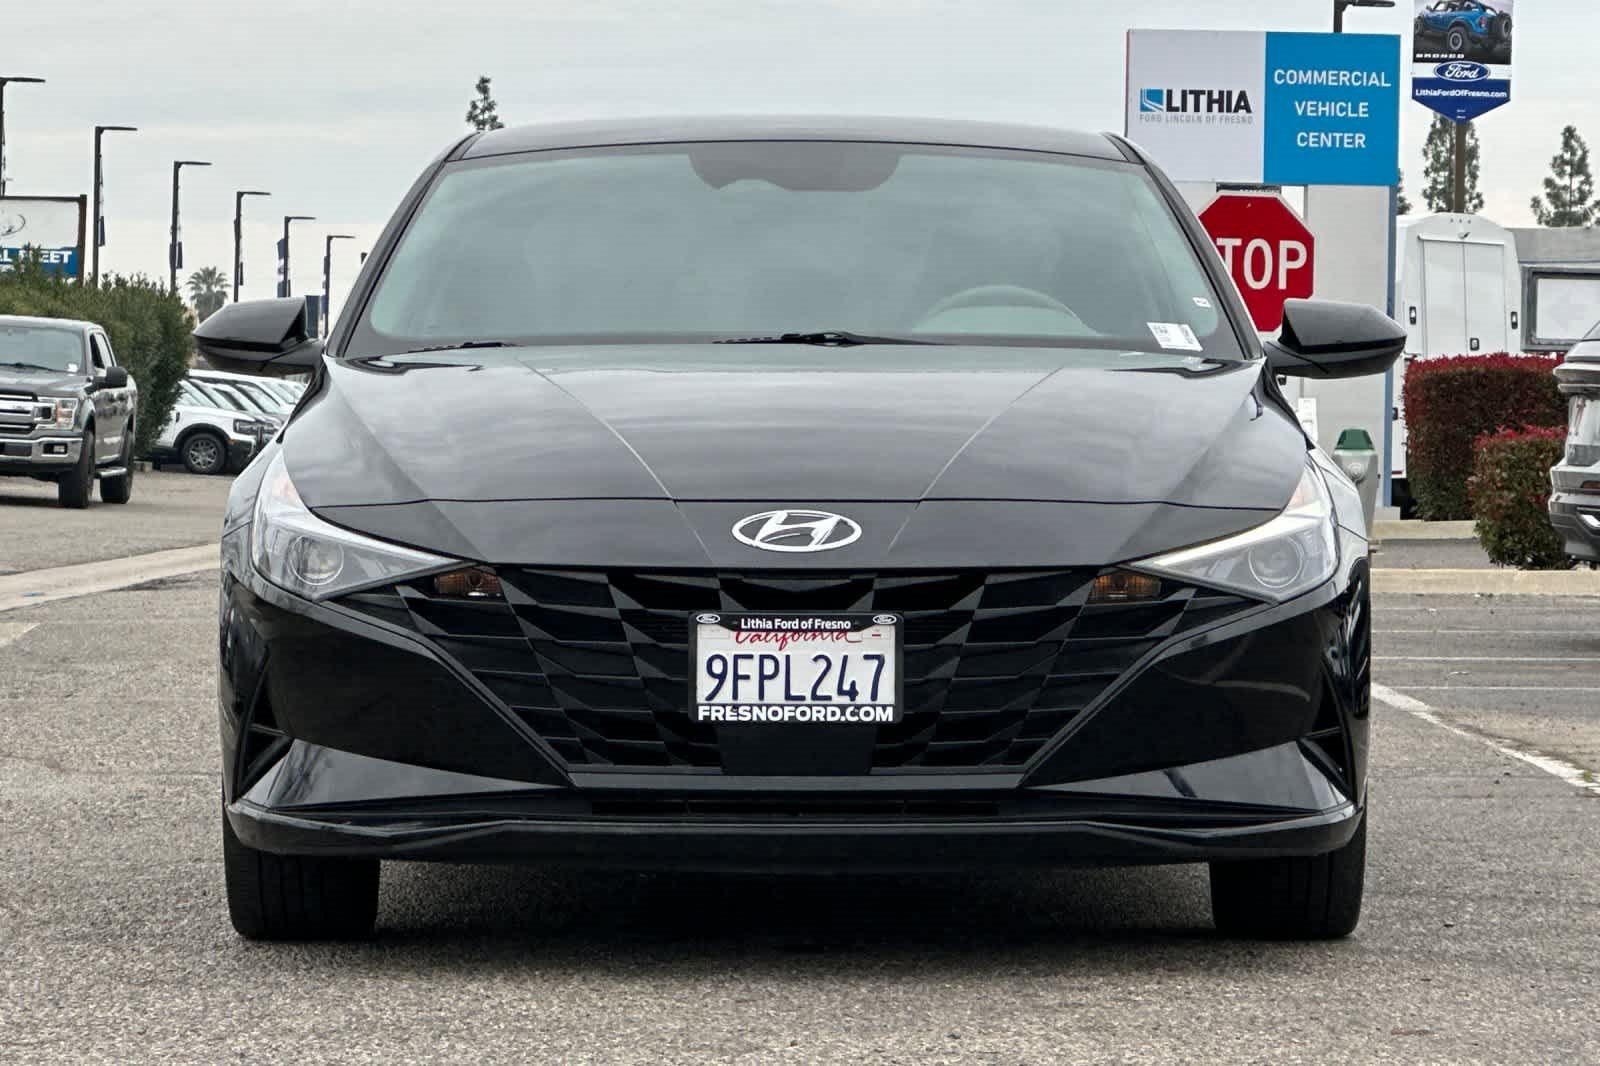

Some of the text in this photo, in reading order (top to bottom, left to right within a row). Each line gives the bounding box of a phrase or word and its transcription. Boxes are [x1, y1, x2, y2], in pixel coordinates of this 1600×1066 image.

[1274, 69, 1392, 87] COMMERCIAL
[1445, 64, 1480, 78] Ford
[1166, 89, 1252, 113] LITHIA
[1415, 88, 1508, 98] LithiaFordOfFresno.com
[1295, 101, 1369, 118] VEHICLE
[1296, 132, 1366, 148] CENTER
[1216, 237, 1308, 291] TOP
[741, 618, 851, 629] Lithia Ford of Fresno
[705, 653, 885, 702] 9FPL247
[698, 706, 894, 721] FRESNOFORD.COM
